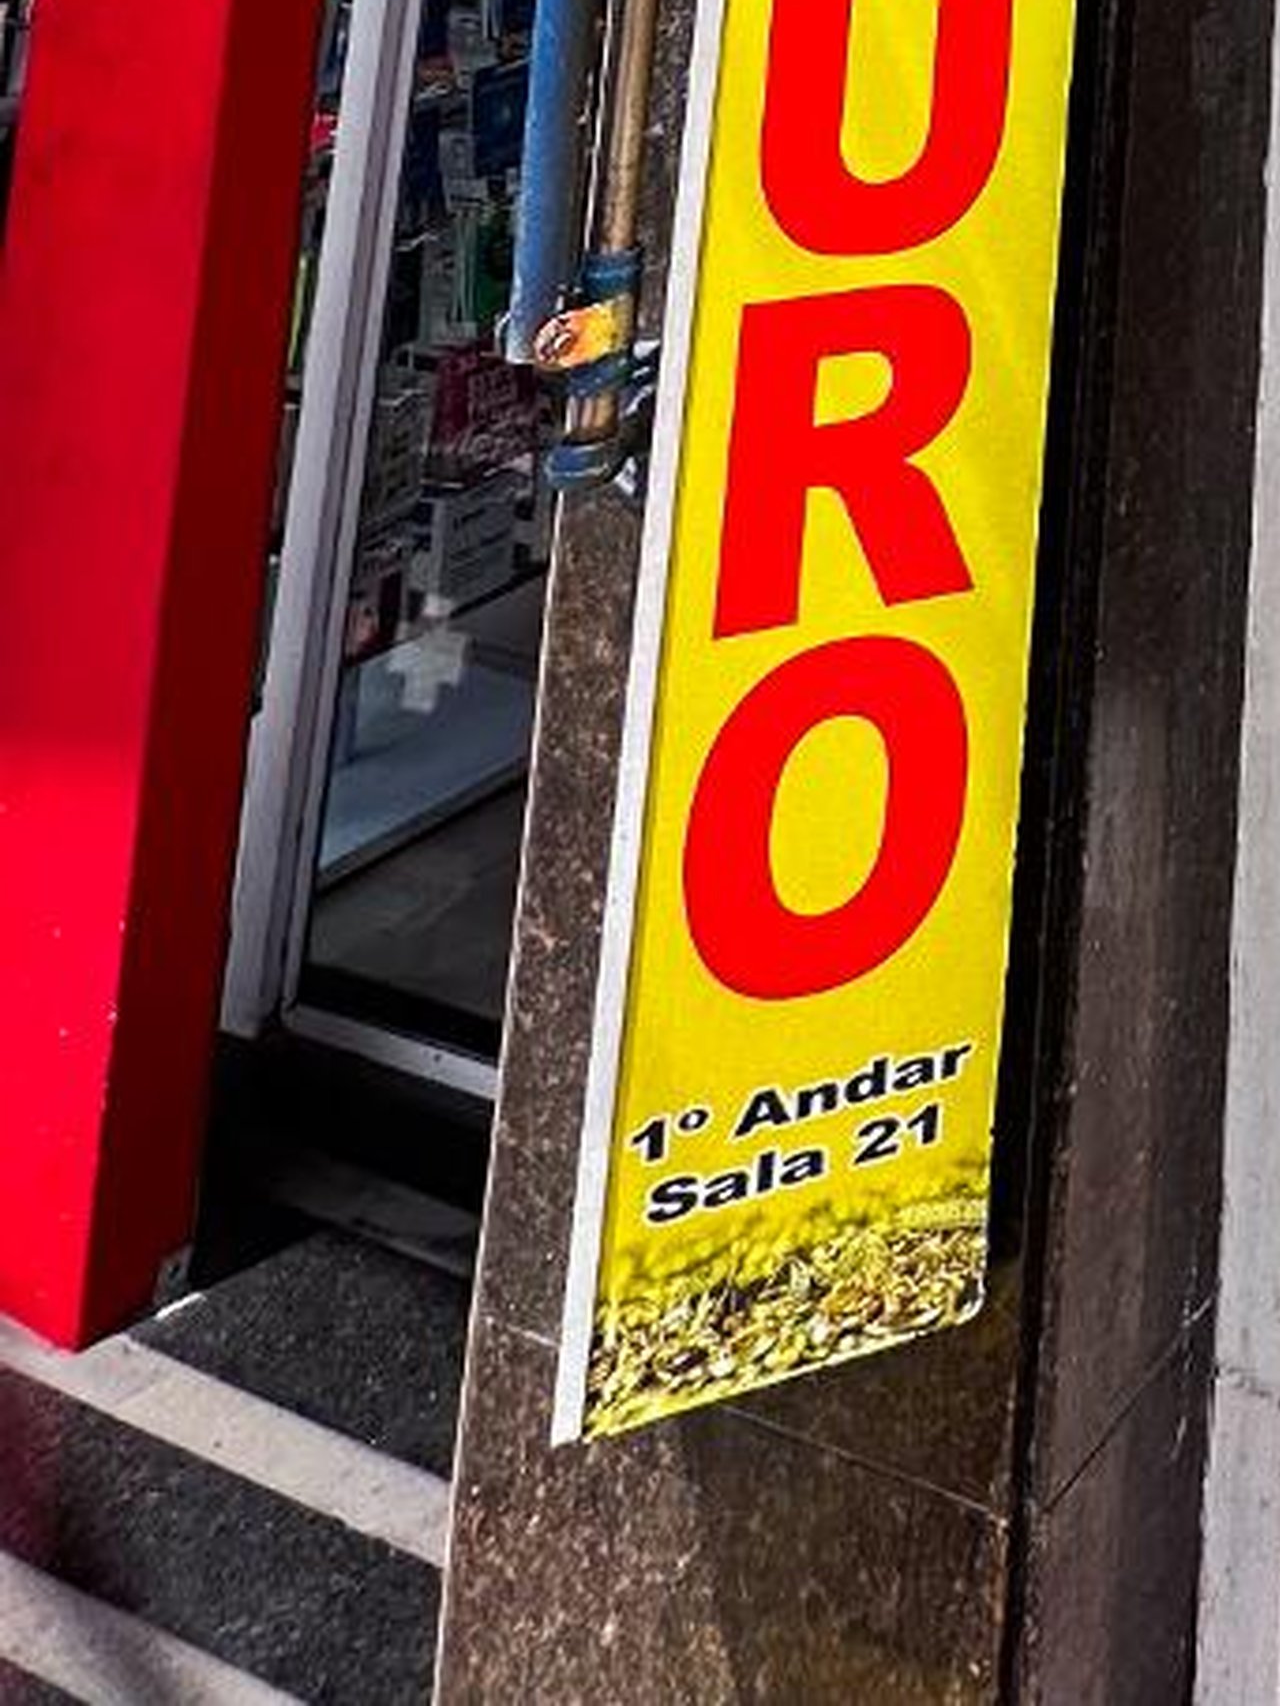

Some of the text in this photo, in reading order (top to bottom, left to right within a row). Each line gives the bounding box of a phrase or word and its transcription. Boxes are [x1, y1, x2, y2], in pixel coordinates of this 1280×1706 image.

[732, 1042, 973, 1139] Andar
[645, 1102, 941, 1225] Sala 21
